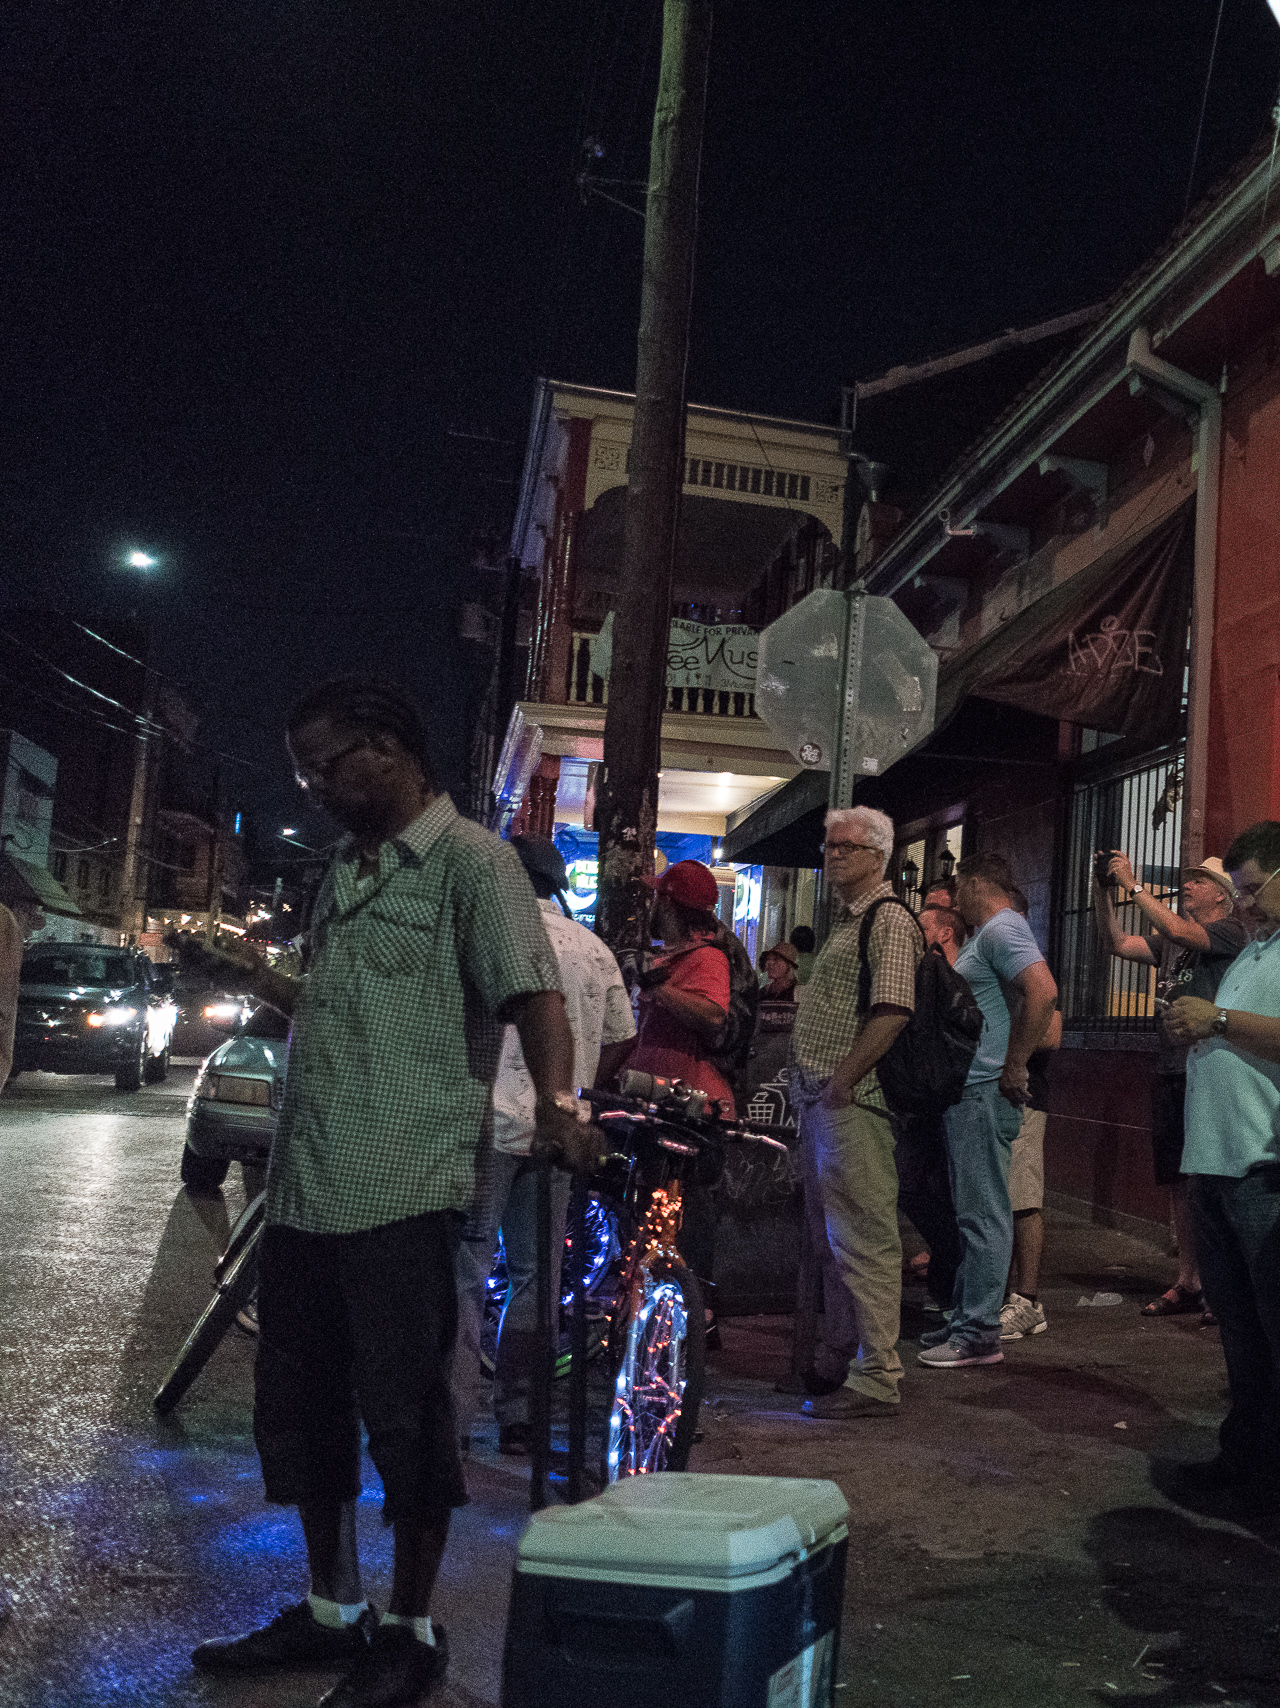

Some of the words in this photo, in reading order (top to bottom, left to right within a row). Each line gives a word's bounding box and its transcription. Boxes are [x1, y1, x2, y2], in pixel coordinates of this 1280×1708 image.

[704, 627, 722, 636] FOR
[726, 627, 758, 637] PRIVA
[668, 651, 700, 671] ee
[699, 636, 758, 680] Mus
